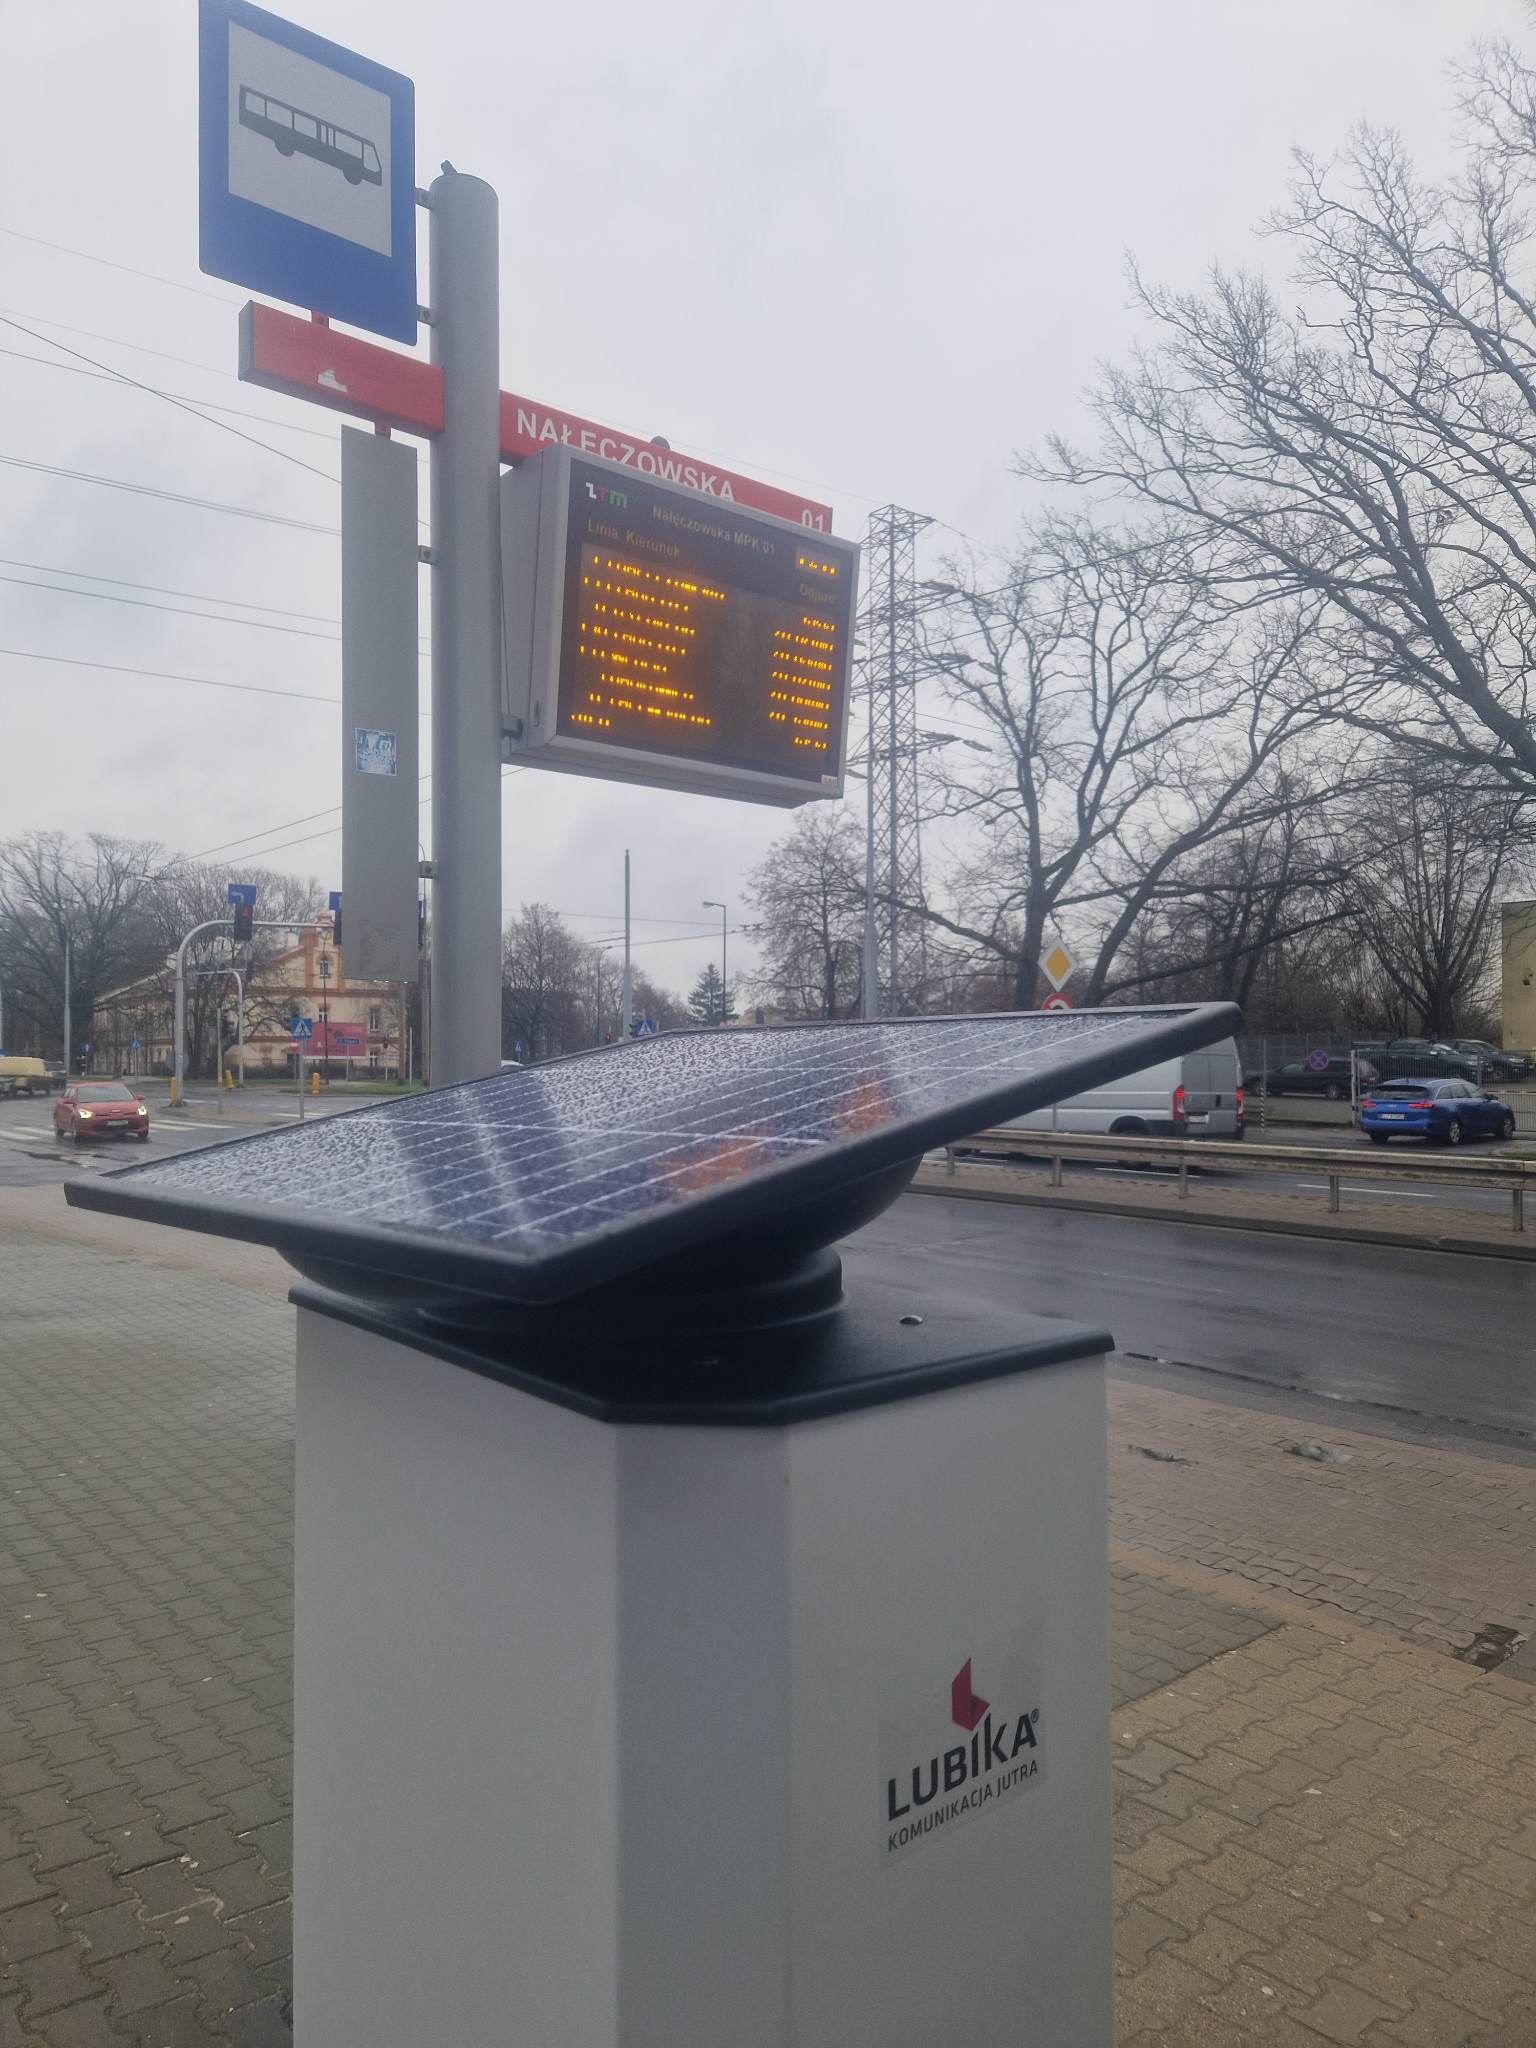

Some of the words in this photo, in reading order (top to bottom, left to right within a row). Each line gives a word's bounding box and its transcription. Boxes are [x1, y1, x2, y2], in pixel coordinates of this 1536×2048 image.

[801, 509, 825, 532] 01
[625, 529, 681, 559] Kierunek
[888, 1783, 993, 1852] KOMUNIKACJA
[997, 1759, 1039, 1798] JUTRA
